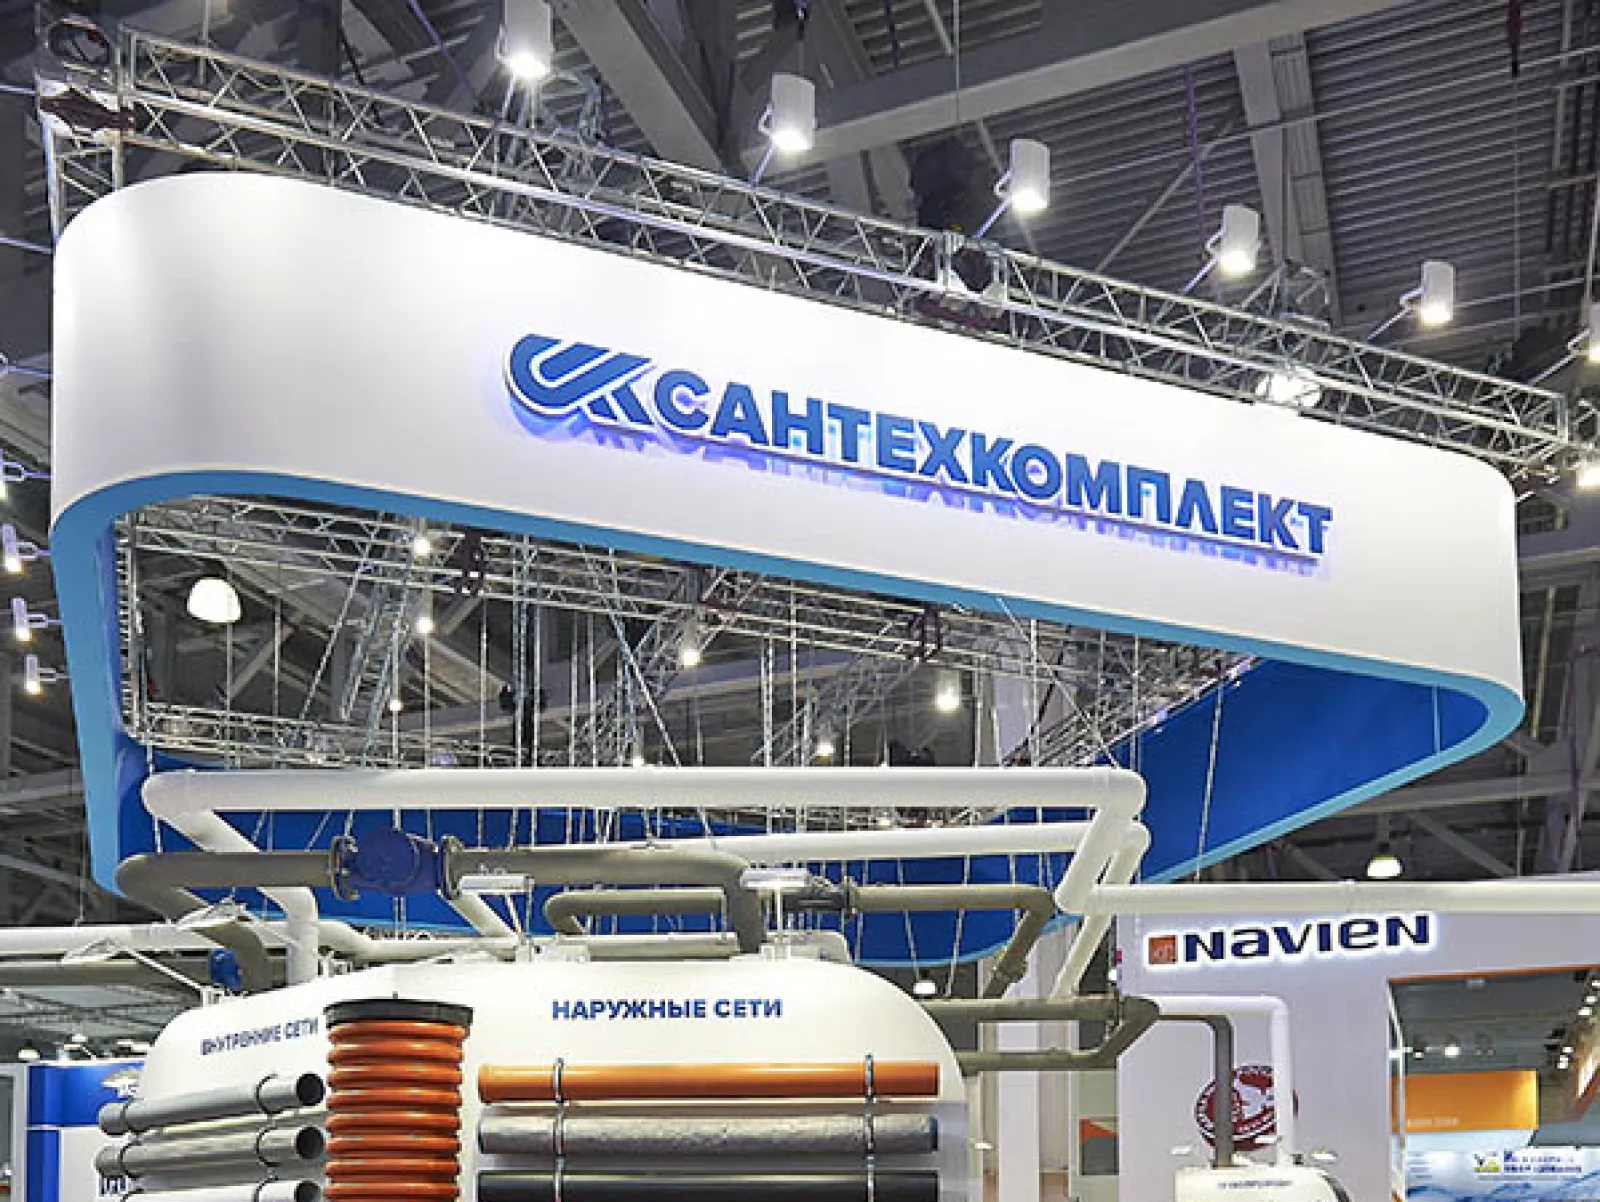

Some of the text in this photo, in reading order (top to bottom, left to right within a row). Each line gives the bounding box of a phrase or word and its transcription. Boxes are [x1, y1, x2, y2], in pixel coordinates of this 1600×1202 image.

[654, 369, 1332, 554] САНТЕХКОМПЛЕКТ
[552, 999, 783, 1019] НАРУЖНЫЕ СЕТИ
